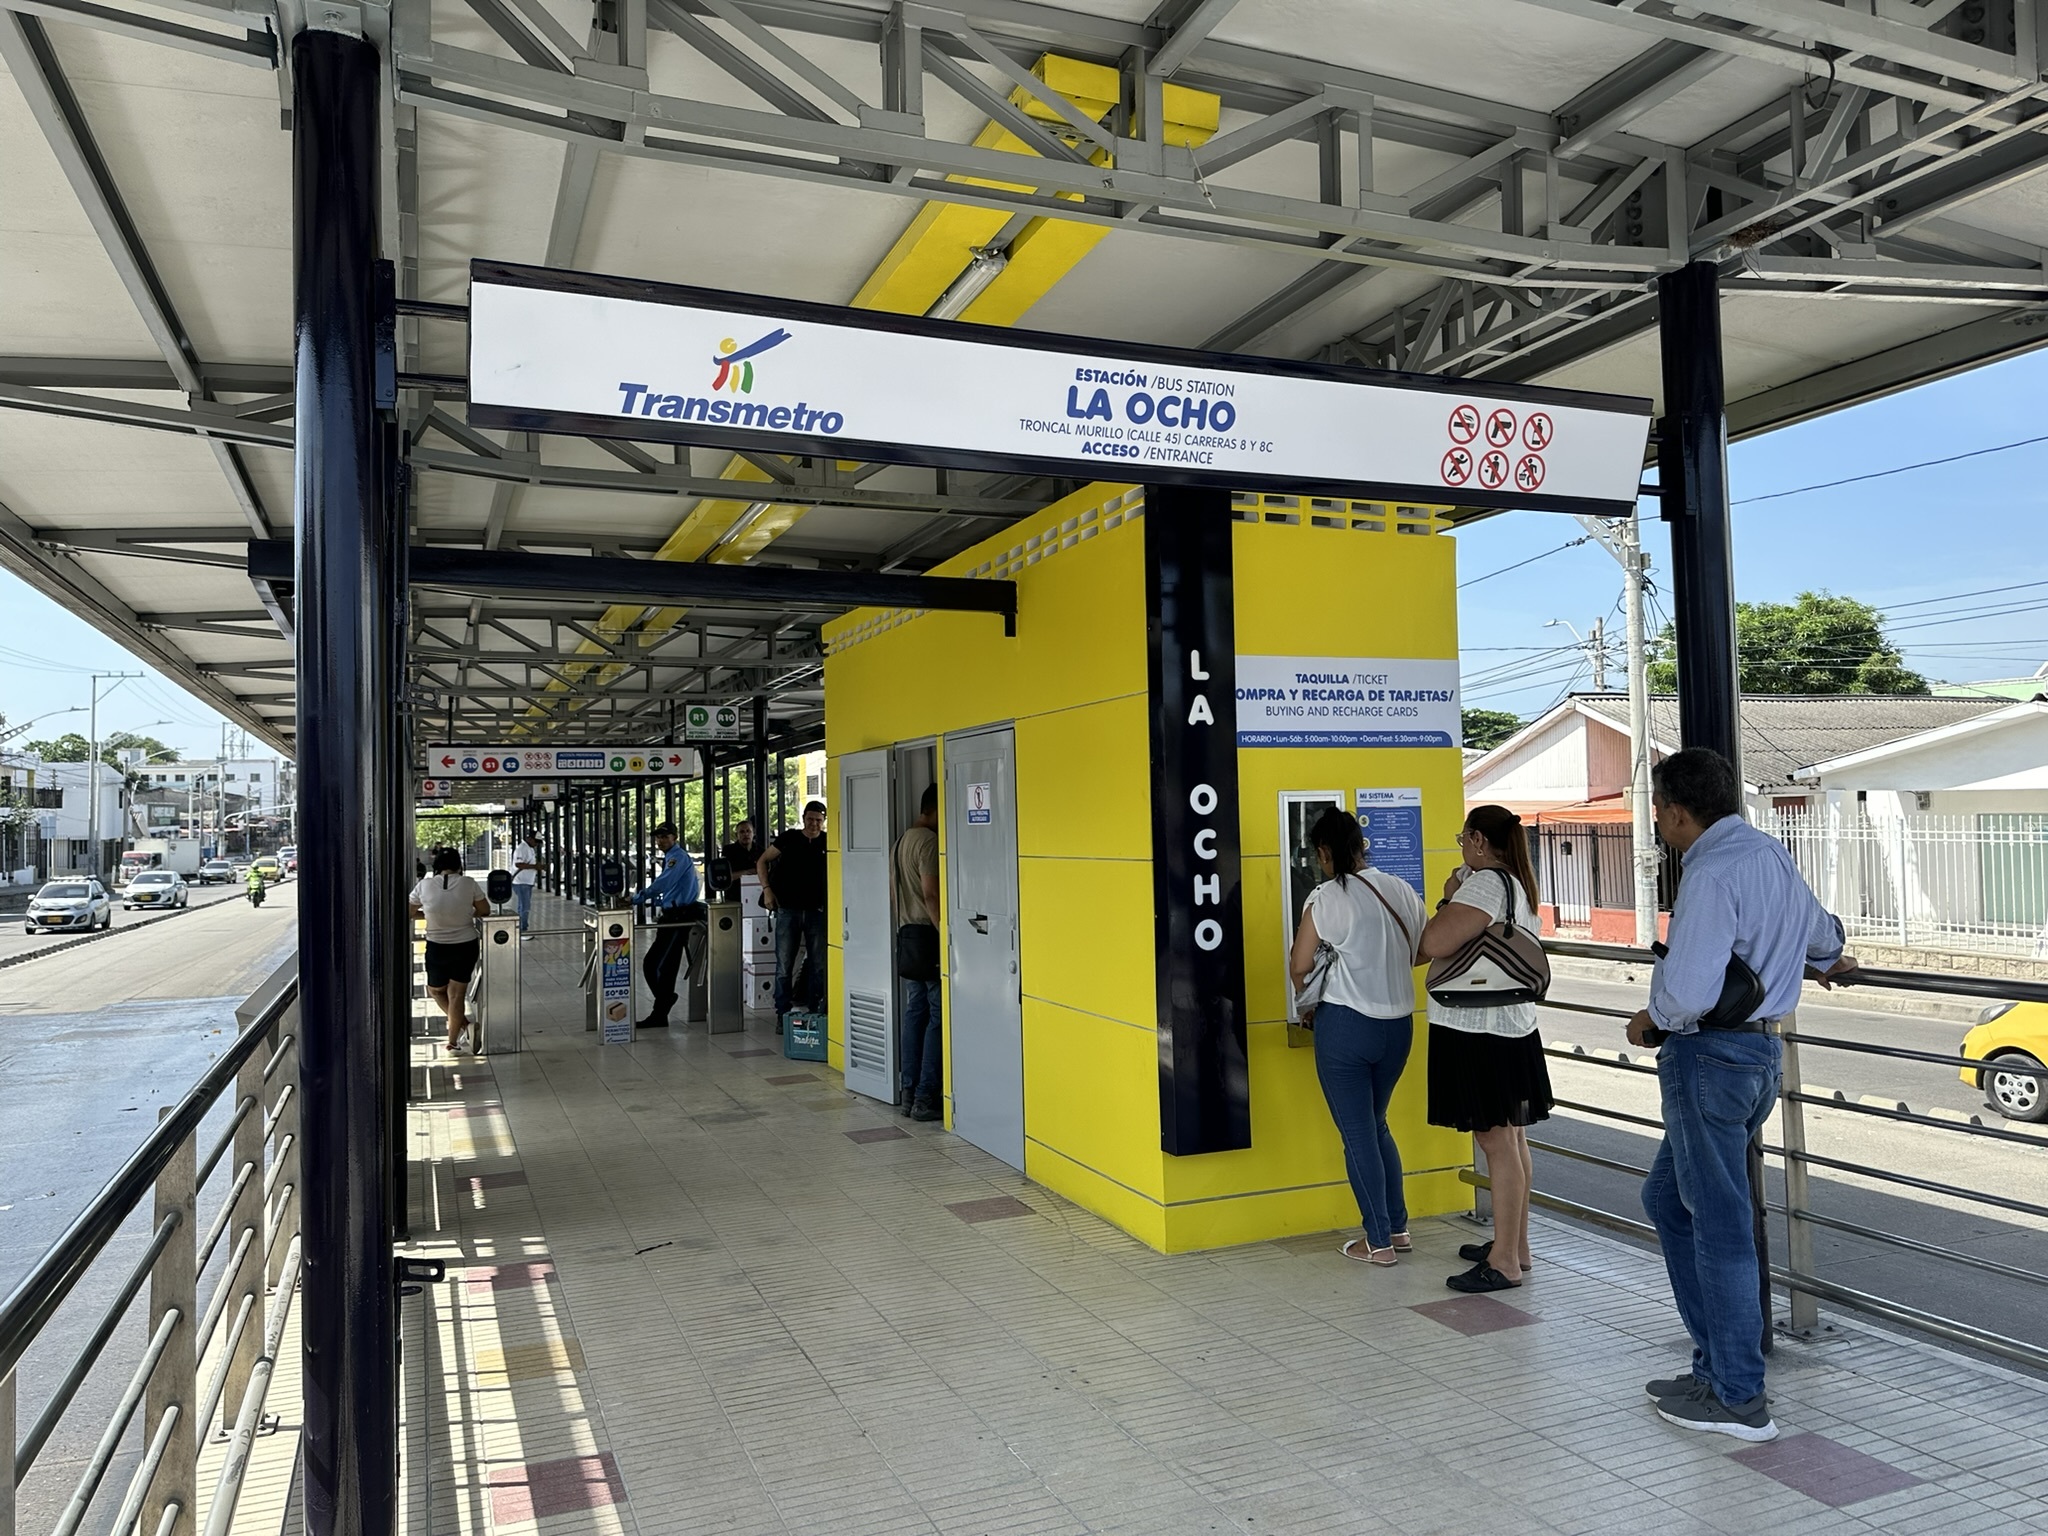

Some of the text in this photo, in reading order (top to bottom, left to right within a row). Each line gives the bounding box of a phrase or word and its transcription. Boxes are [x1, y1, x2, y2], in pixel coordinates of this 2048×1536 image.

[1075, 368, 1148, 388] ESTACIÓN
[1186, 380, 1235, 397] STATION
[618, 382, 844, 434] Transmetro
[1066, 385, 1236, 432] LA OCHO
[1019, 418, 1274, 453] TRONCAL MURILLO (CALLE 45) CARRERAS 8 Y 8C
[1081, 441, 1214, 465] ACCESO /ENTRANCE
[1188, 649, 1215, 726] LA
[1295, 673, 1350, 685] TAQUILLA
[1236, 687, 1454, 702] OMPRA Y RECARGA DE TARJETAS/
[693, 713, 735, 722] R1 R10
[1265, 705, 1419, 717] BUYING AND RECHARGE CARDS
[1241, 734, 1272, 743] HORARIO
[1368, 792, 1394, 800] SISTEMA
[1189, 783, 1223, 951] OCHO
[617, 957, 629, 965] 80
